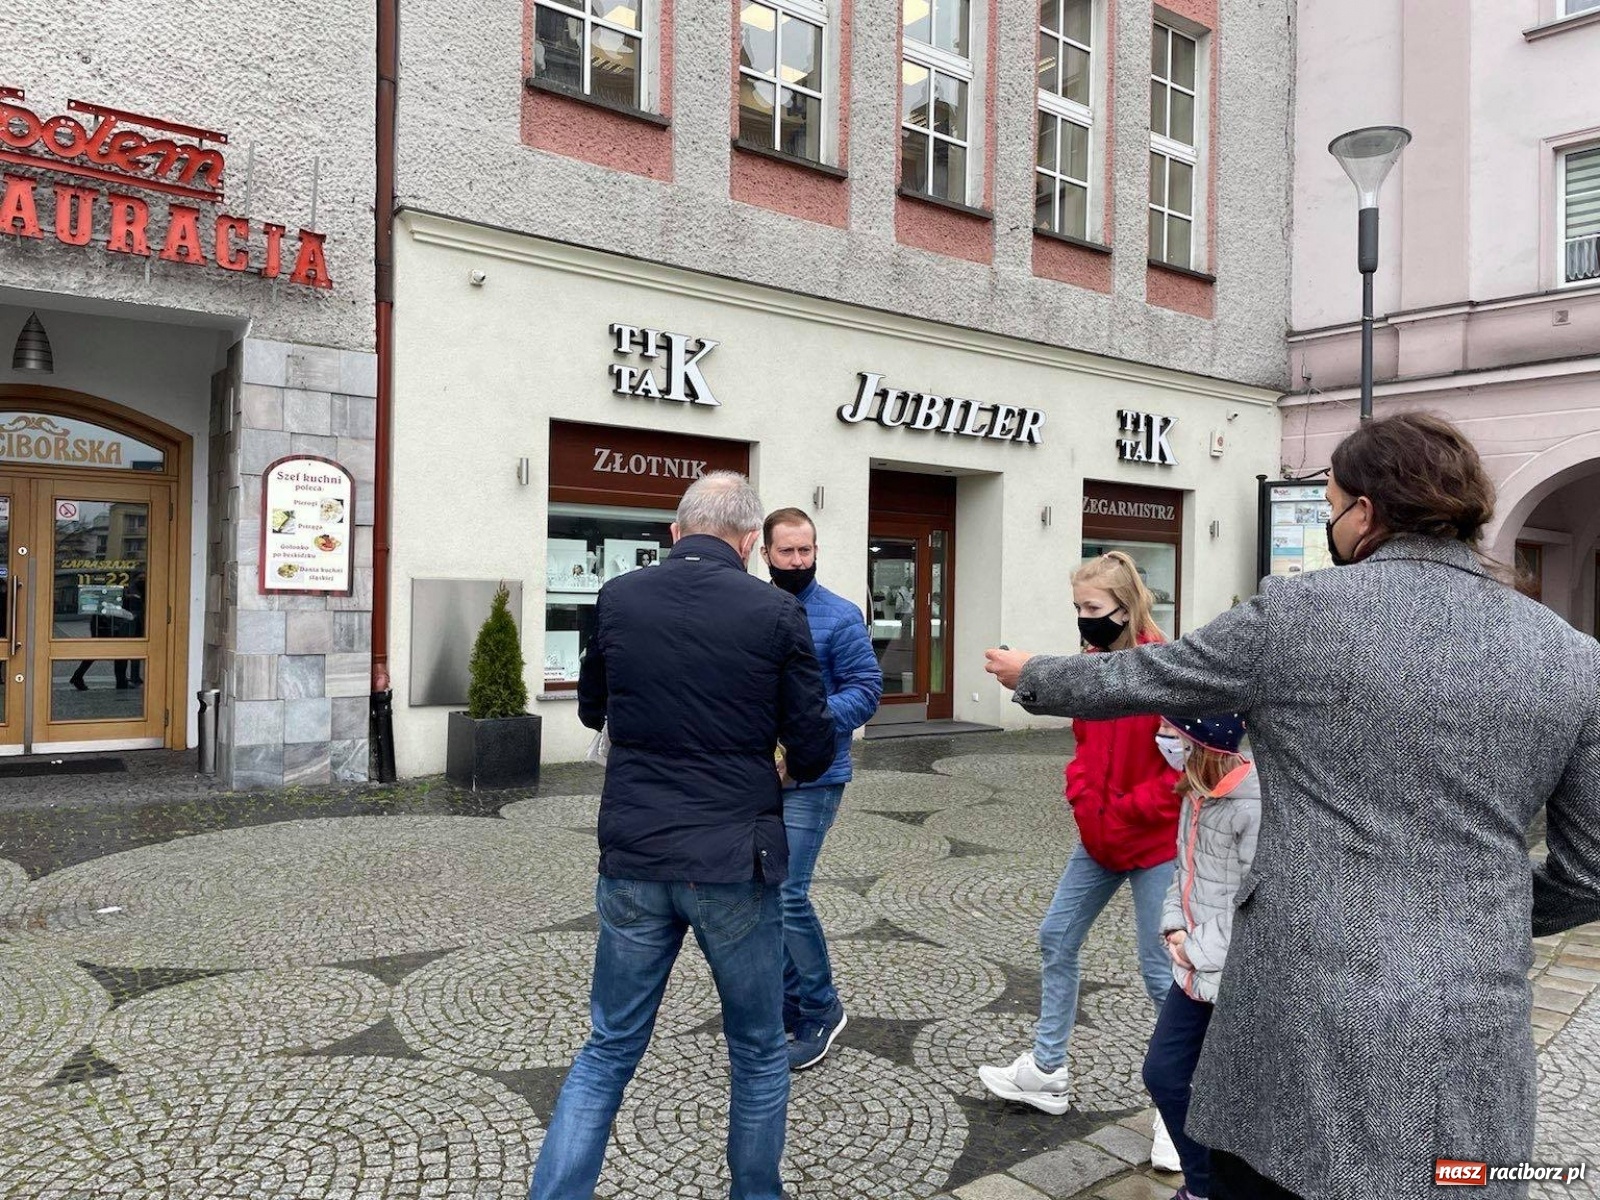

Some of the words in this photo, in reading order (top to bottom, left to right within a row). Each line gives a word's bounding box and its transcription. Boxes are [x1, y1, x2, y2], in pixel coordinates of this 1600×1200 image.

[837, 371, 1046, 445] JUBILER
[593, 447, 708, 480] ZŁOTNIK
[277, 472, 301, 481] Szef
[303, 473, 342, 484] kuchni
[1082, 496, 1175, 520] ZEGARMISTRZ
